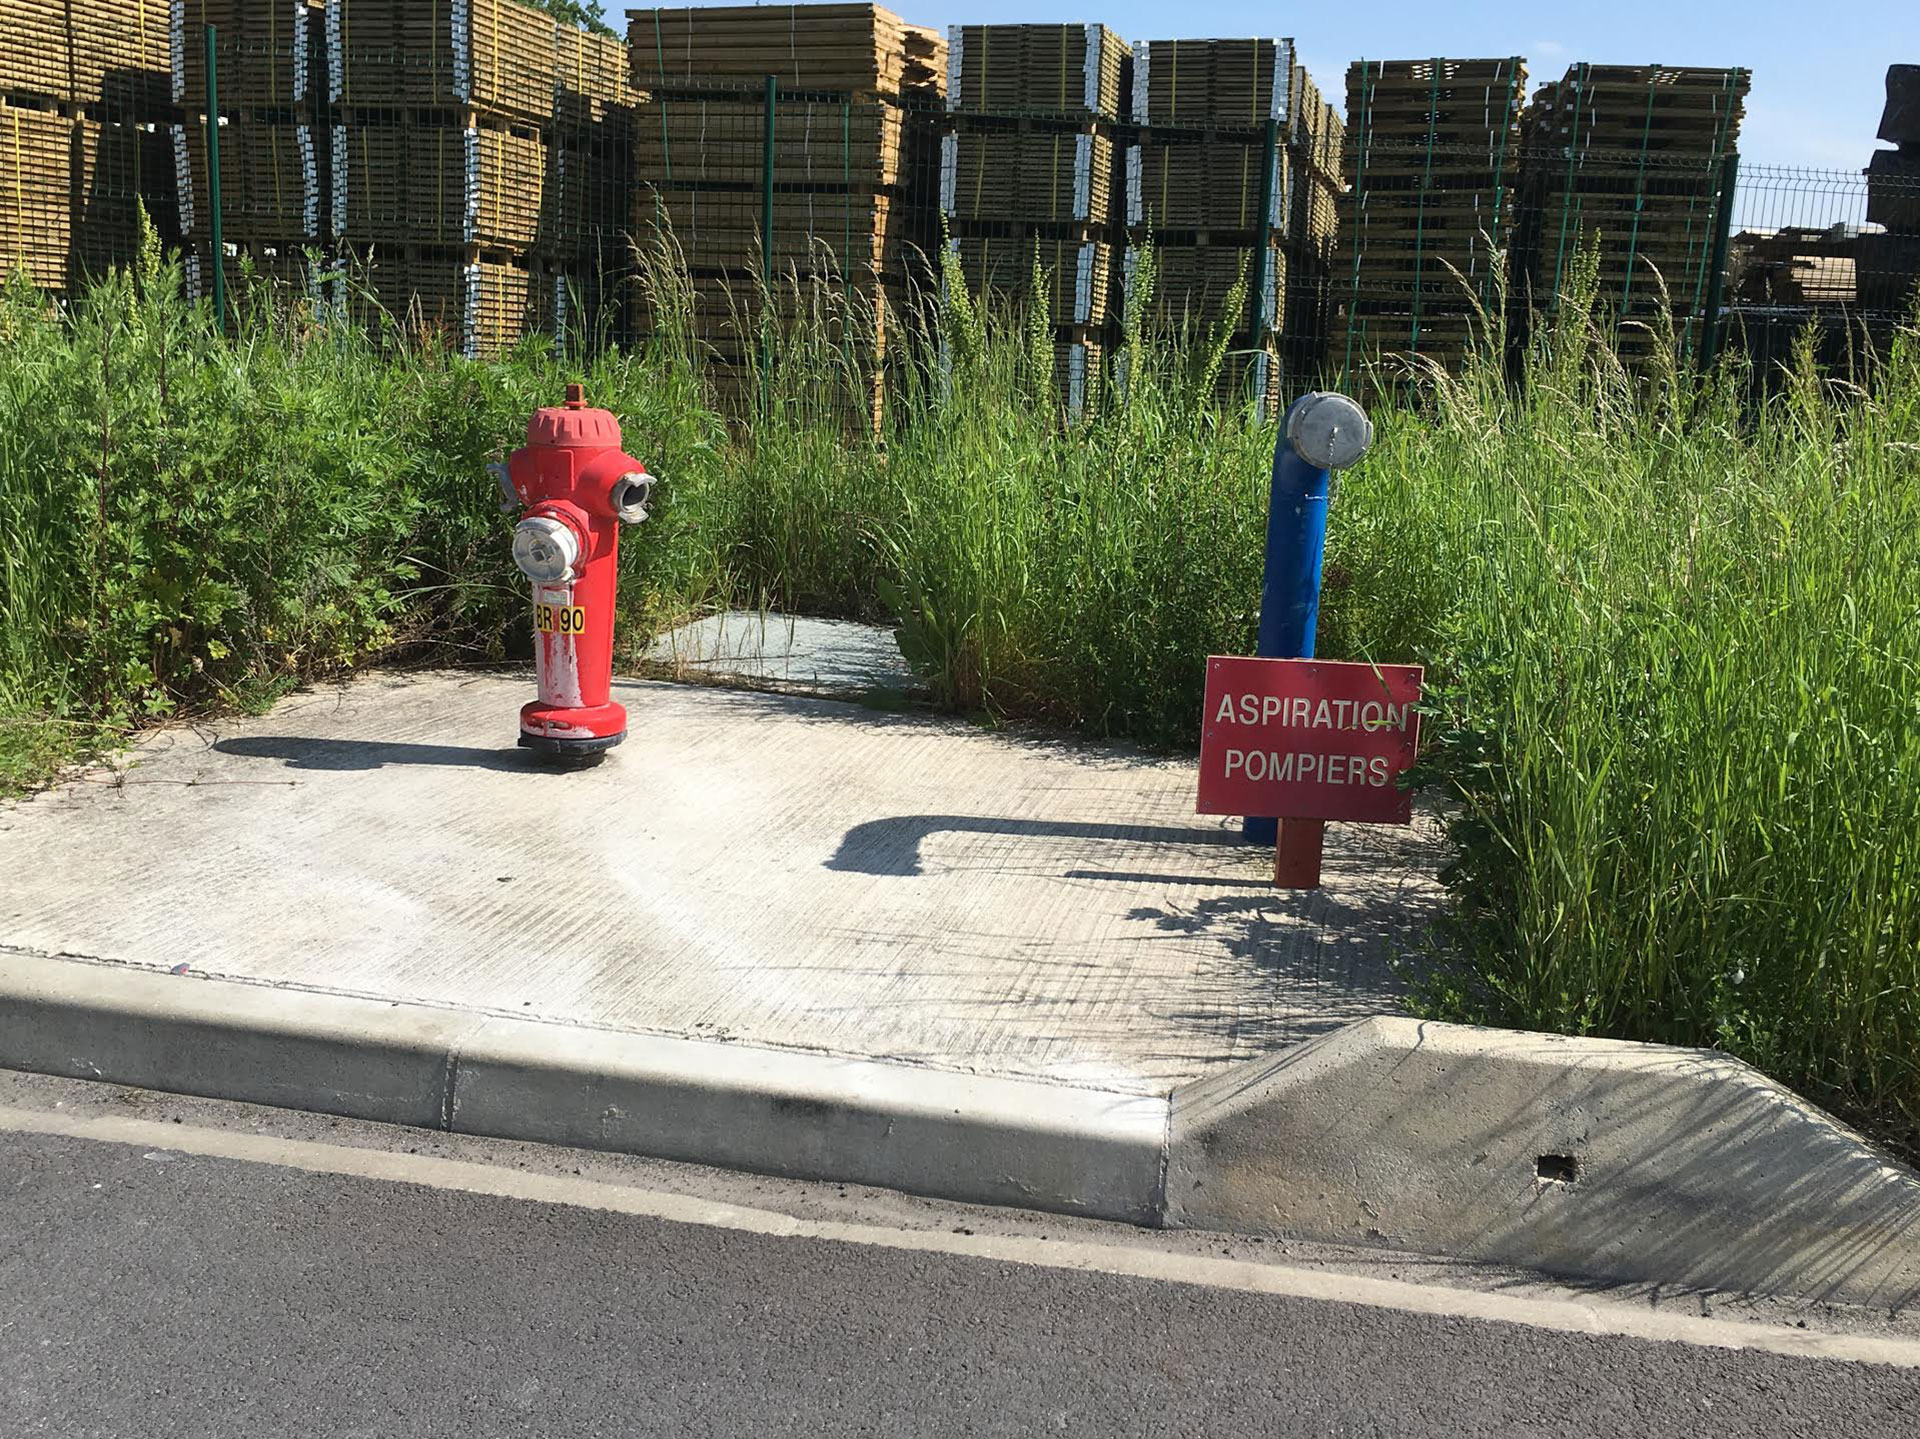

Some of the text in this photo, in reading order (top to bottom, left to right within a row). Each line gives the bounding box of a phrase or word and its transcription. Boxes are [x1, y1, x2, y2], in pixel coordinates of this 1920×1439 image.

[560, 608, 584, 631] 90
[1215, 694, 1409, 732] ASPIRATION
[1224, 749, 1389, 787] POMPIERS
